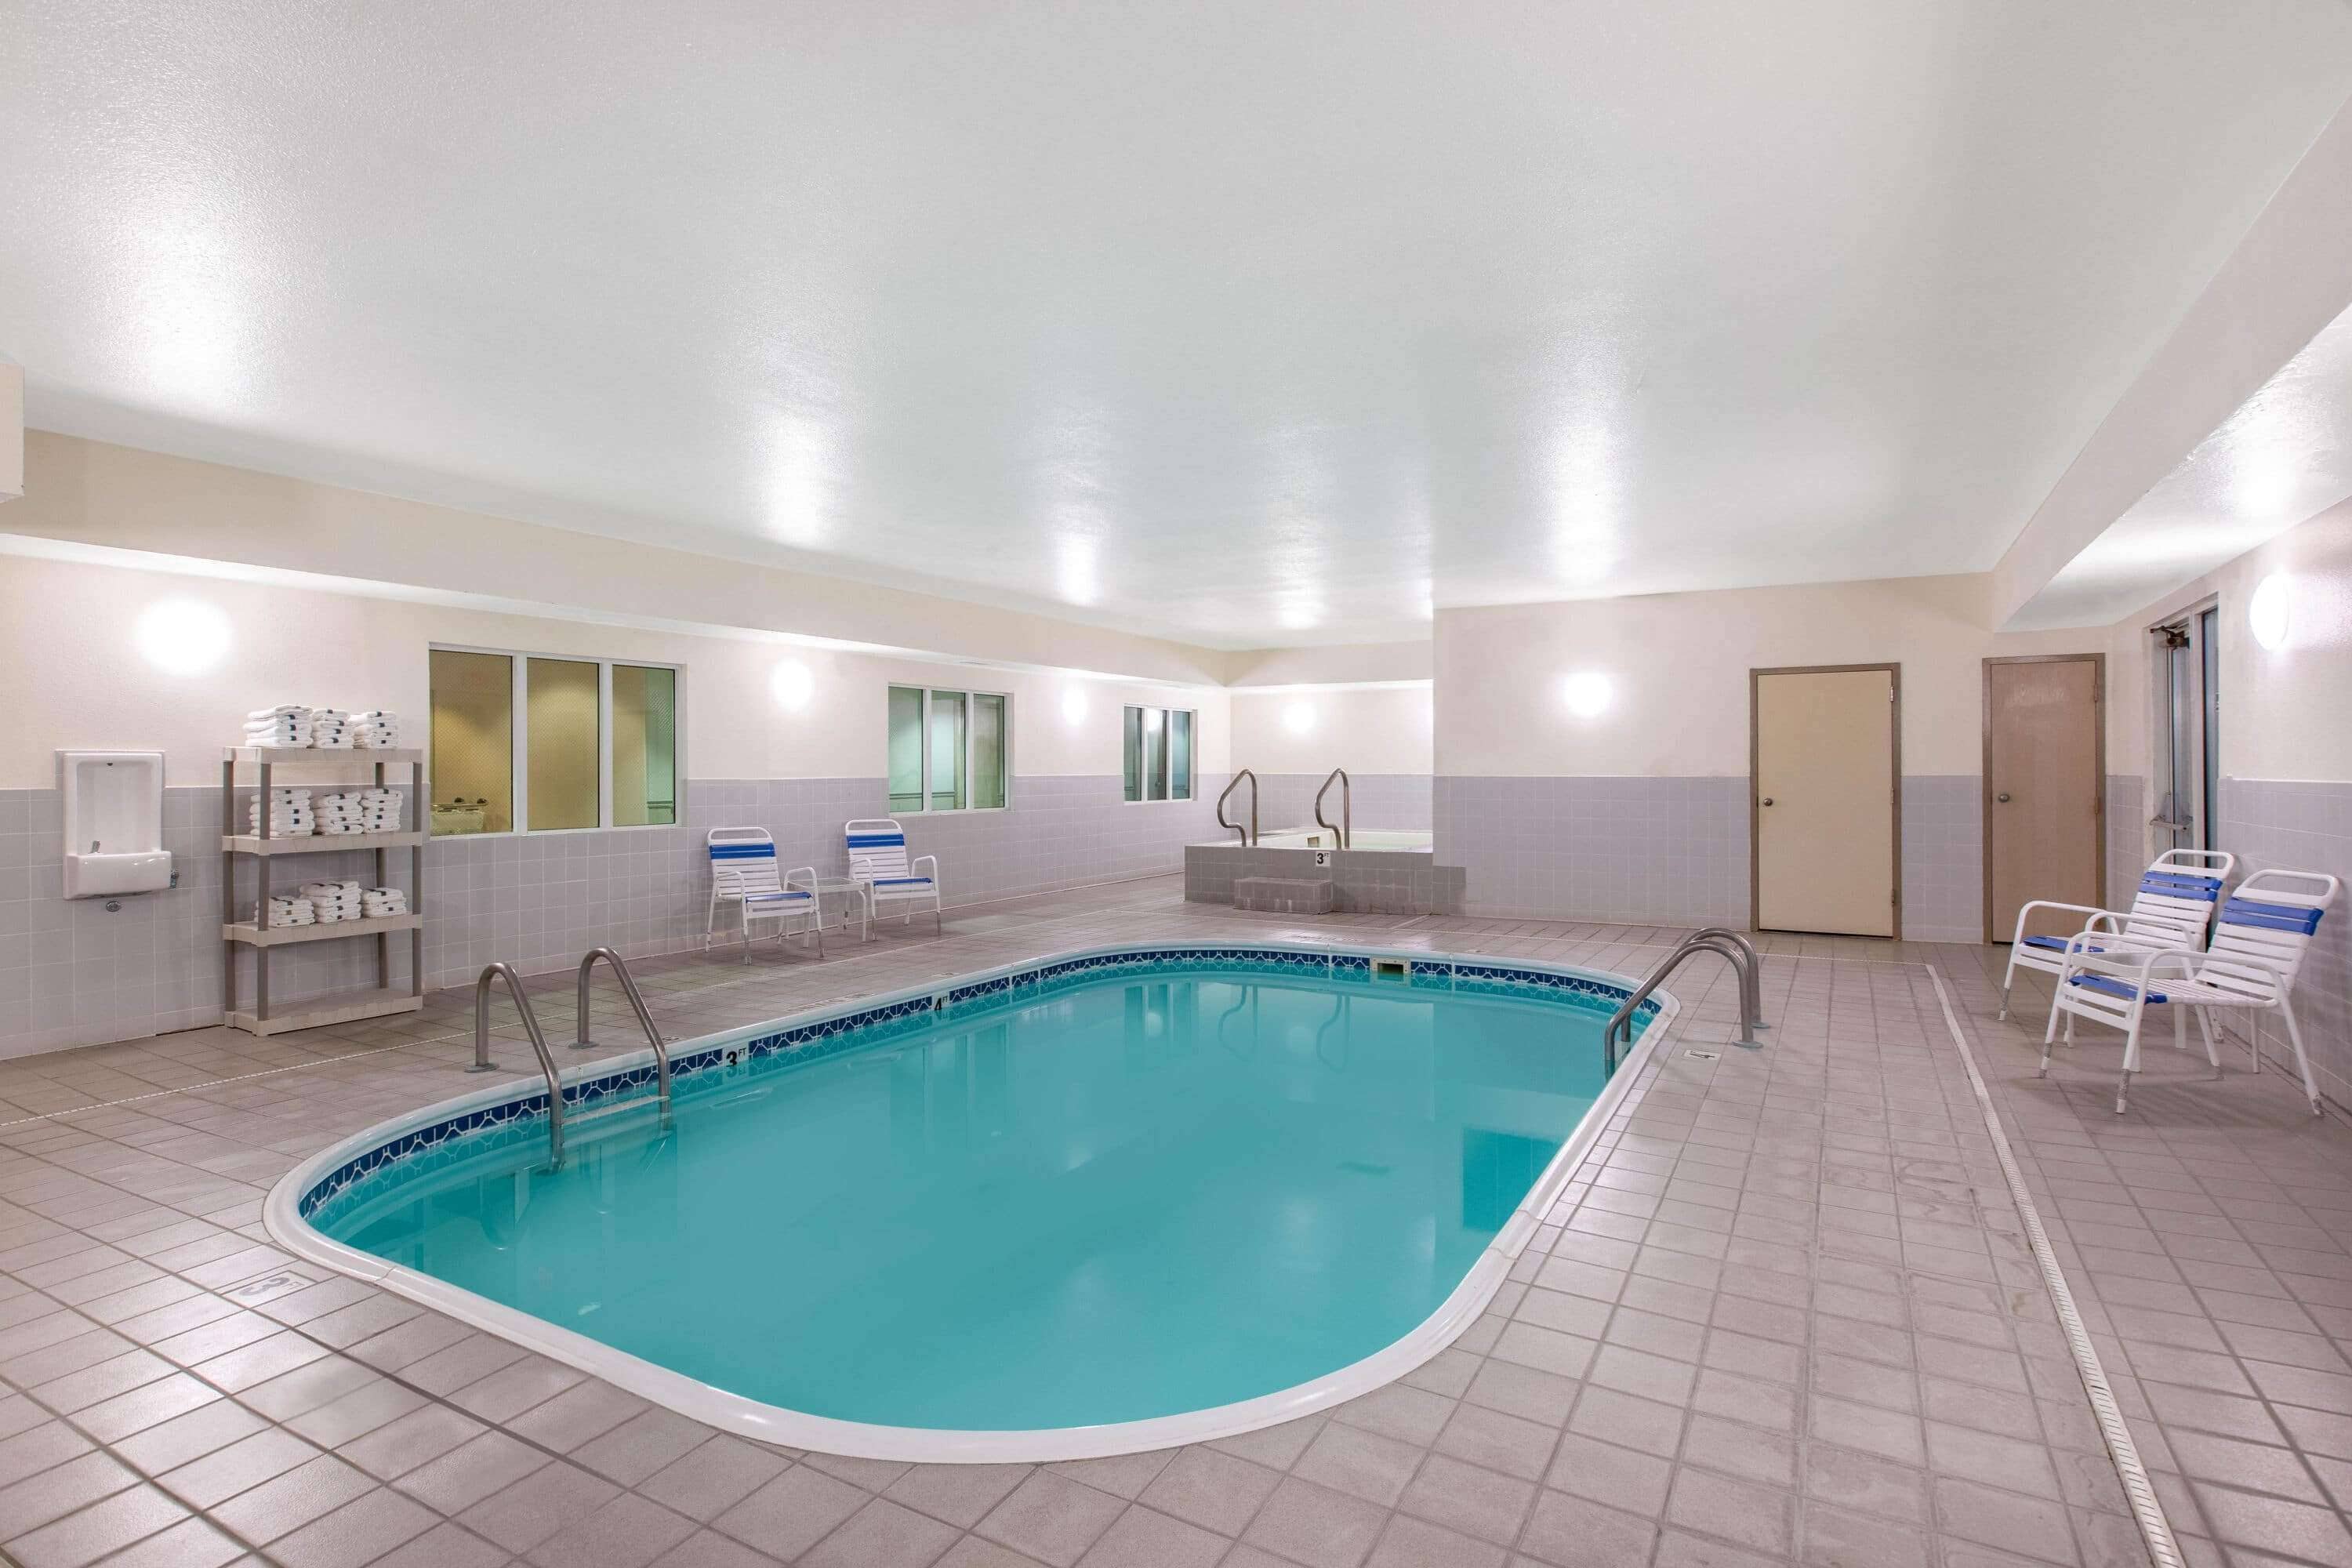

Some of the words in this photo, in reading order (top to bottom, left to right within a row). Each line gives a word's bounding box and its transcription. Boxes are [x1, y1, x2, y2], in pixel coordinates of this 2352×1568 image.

[1316, 852, 1324, 865] 3
[935, 997, 942, 1011] 4
[726, 1051, 738, 1068] 3
[739, 1047, 747, 1057] FT
[238, 1276, 290, 1296] 3
